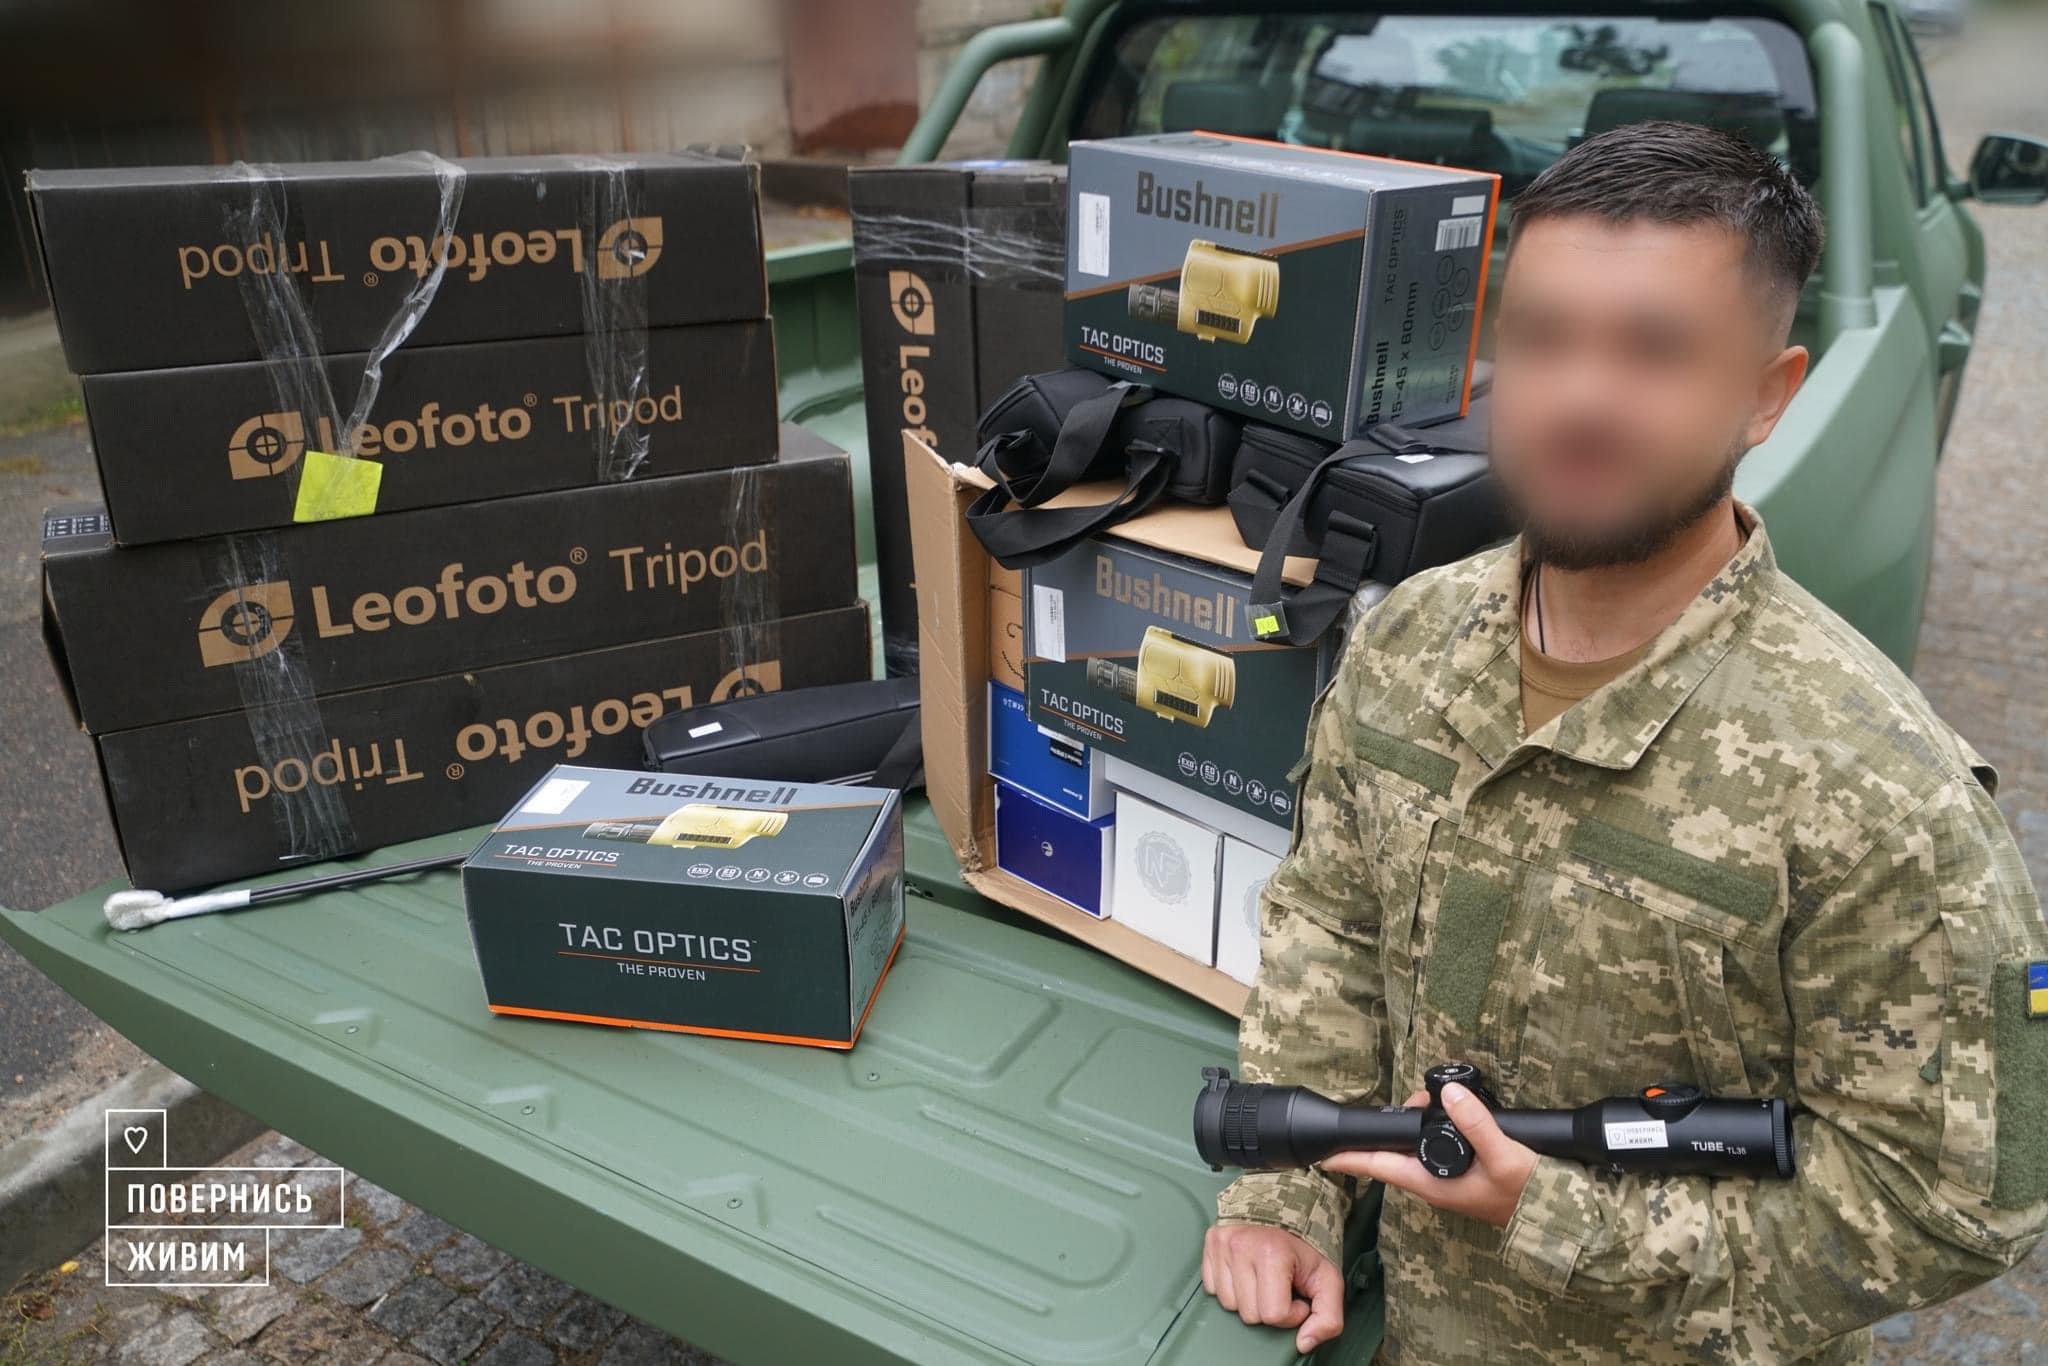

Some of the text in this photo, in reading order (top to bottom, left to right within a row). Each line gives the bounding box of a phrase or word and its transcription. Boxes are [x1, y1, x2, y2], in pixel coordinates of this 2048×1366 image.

[1136, 170, 1279, 239] Bushnell
[177, 231, 345, 289] Tripod
[1384, 274, 1397, 305] TAC
[1081, 326, 1165, 365] TAC OPTICS
[1103, 356, 1142, 375] THE PROVEN
[1367, 341, 1390, 425] Bushnell
[553, 385, 683, 436] Tripod
[311, 529, 769, 638] Leofoto Tripod
[1095, 555, 1236, 638] Bushnell
[1041, 689, 1069, 713] TAC
[1072, 700, 1124, 735] OPTICS
[1063, 718, 1102, 741] THE PROVEN
[233, 738, 424, 813] Tripod
[625, 777, 799, 806] Bushnell
[504, 844, 620, 863] TAC OPTICS
[545, 861, 582, 870] PROVEN
[558, 922, 752, 963] TAC OPTICS
[616, 962, 706, 981] THE PROVEN
[1691, 1141, 1724, 1152] TUBE
